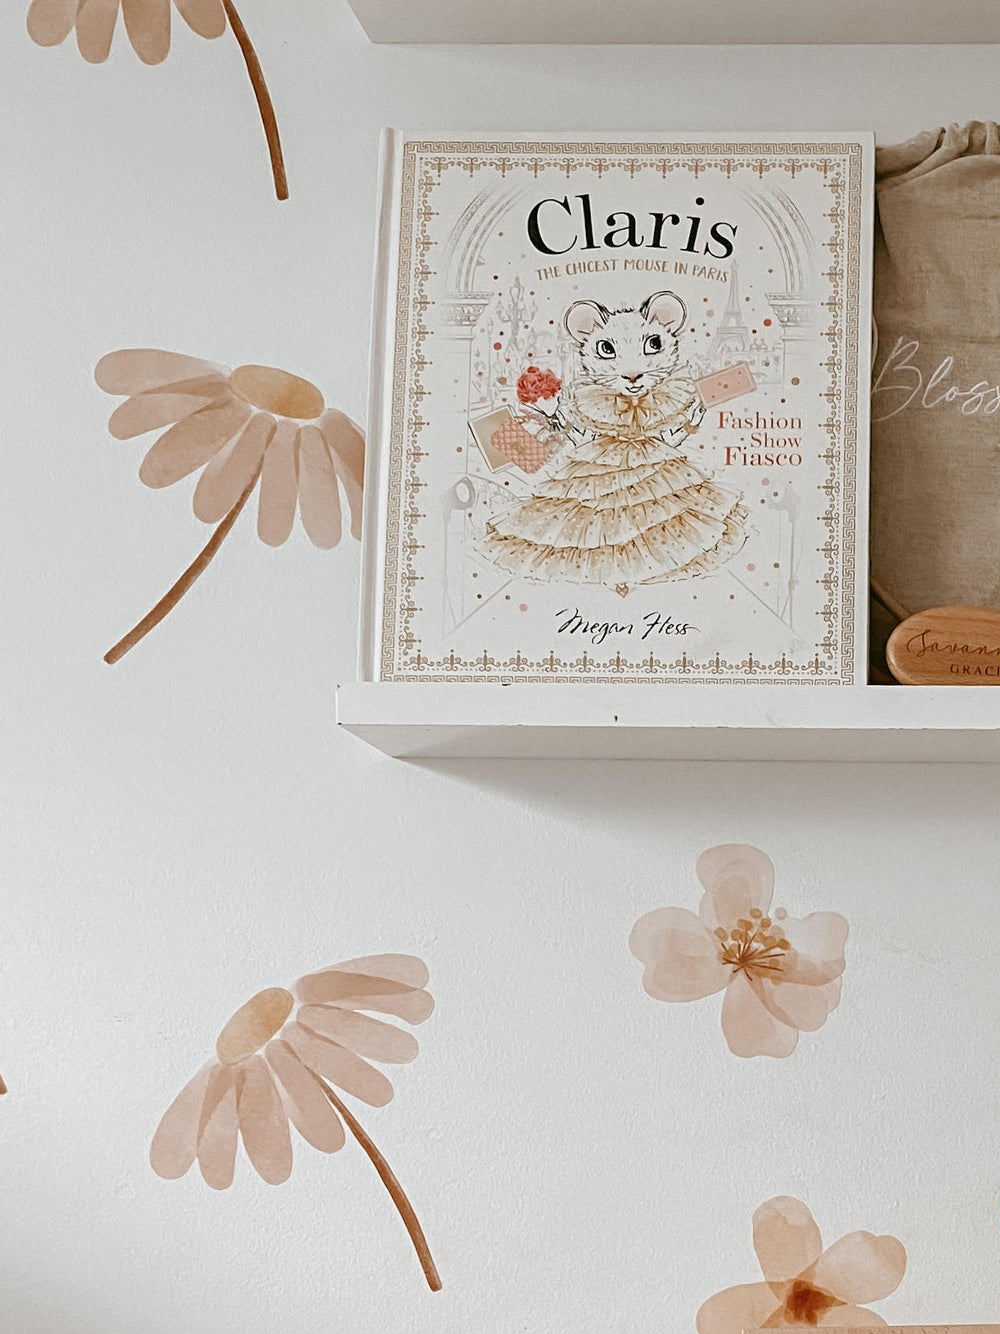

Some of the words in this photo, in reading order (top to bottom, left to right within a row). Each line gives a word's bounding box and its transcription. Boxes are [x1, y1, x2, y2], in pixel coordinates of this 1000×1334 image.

[527, 193, 739, 259] Claris
[535, 266, 561, 281] THE
[566, 258, 619, 275] CHICEST
[623, 259, 669, 272] MOUSE
[674, 261, 688, 275] IN
[692, 265, 729, 283] PARIS
[716, 411, 802, 429] Fashion
[750, 432, 802, 448] Show
[724, 445, 802, 466] Fiasco
[555, 607, 634, 645] Megan
[641, 611, 701, 640] Hess
